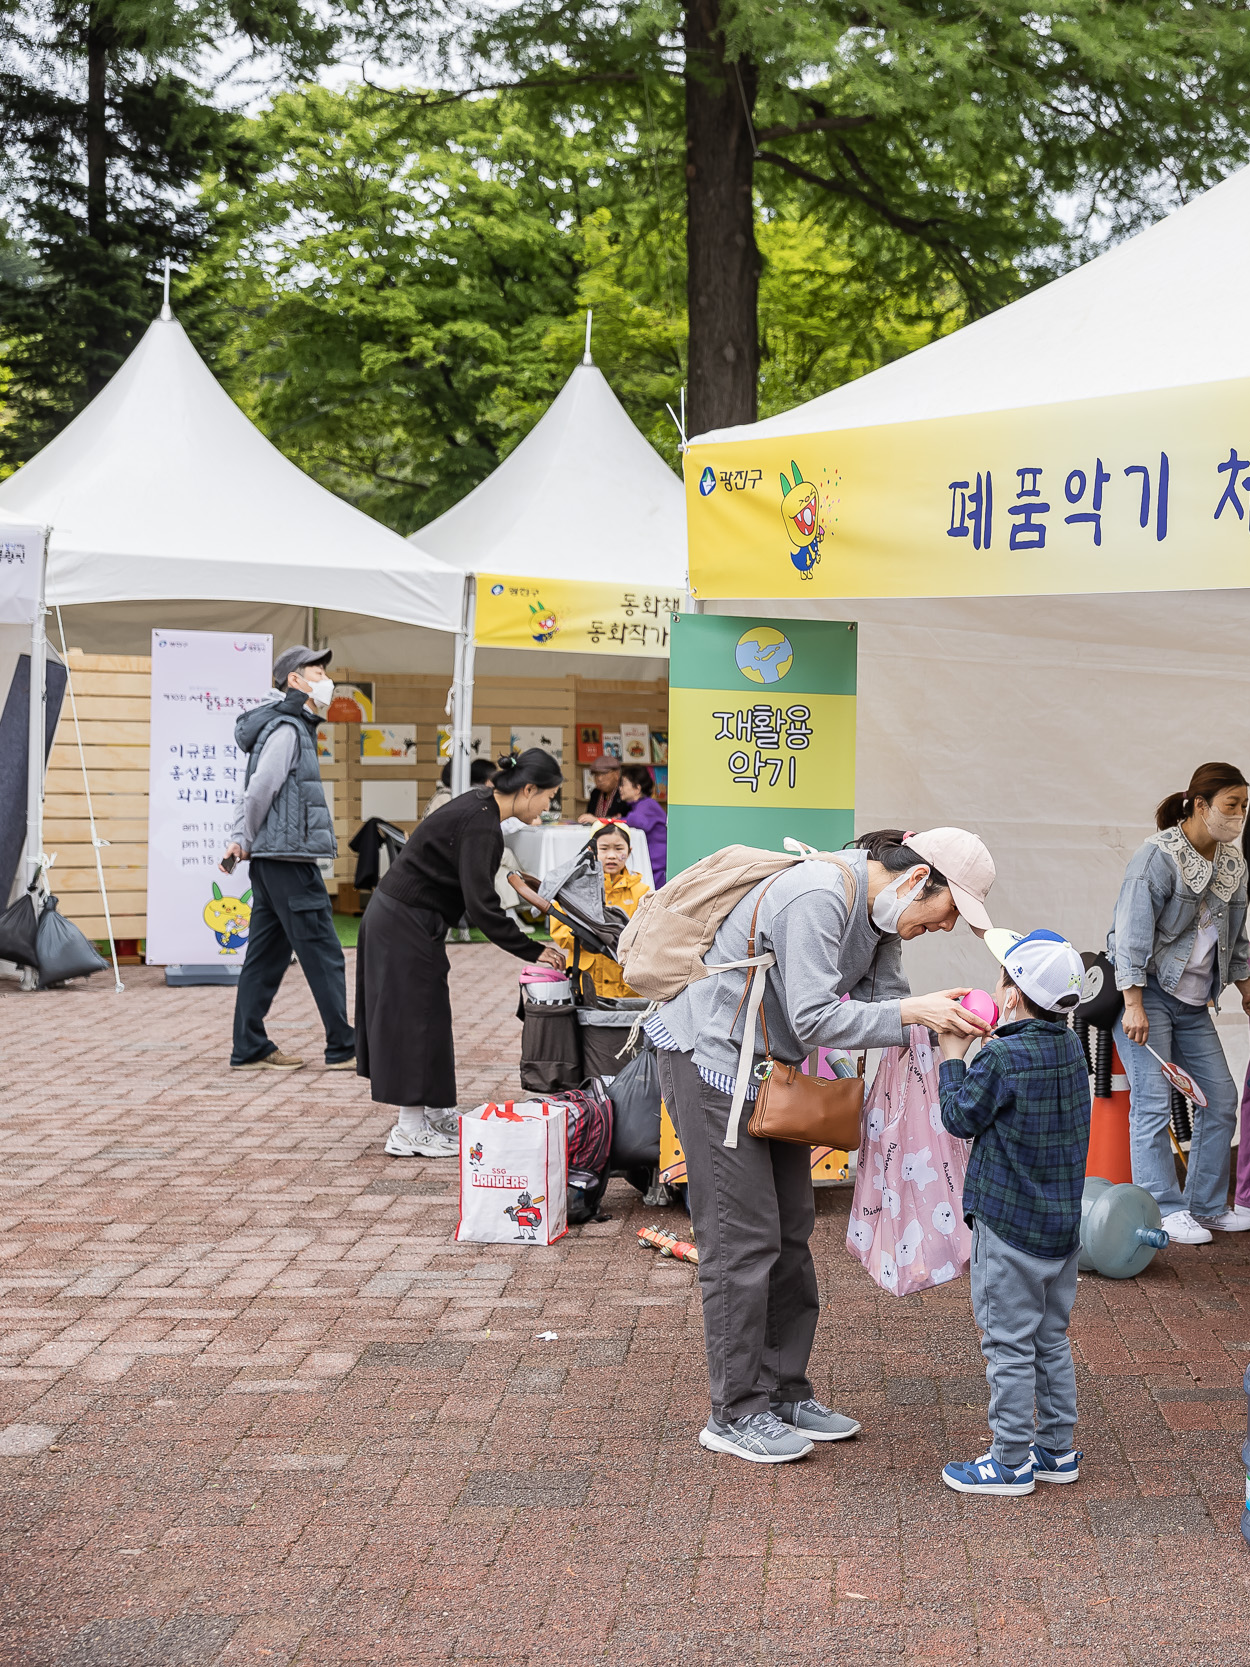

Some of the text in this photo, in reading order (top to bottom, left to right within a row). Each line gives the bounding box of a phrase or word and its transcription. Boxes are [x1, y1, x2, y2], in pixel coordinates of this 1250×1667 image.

[719, 469, 763, 492] 광진구
[947, 451, 1170, 551] 폐품악기
[712, 703, 812, 751] 재활용
[727, 750, 796, 793] 악기
[472, 1173, 528, 1190] LANDERS
[977, 1463, 997, 1480] N
